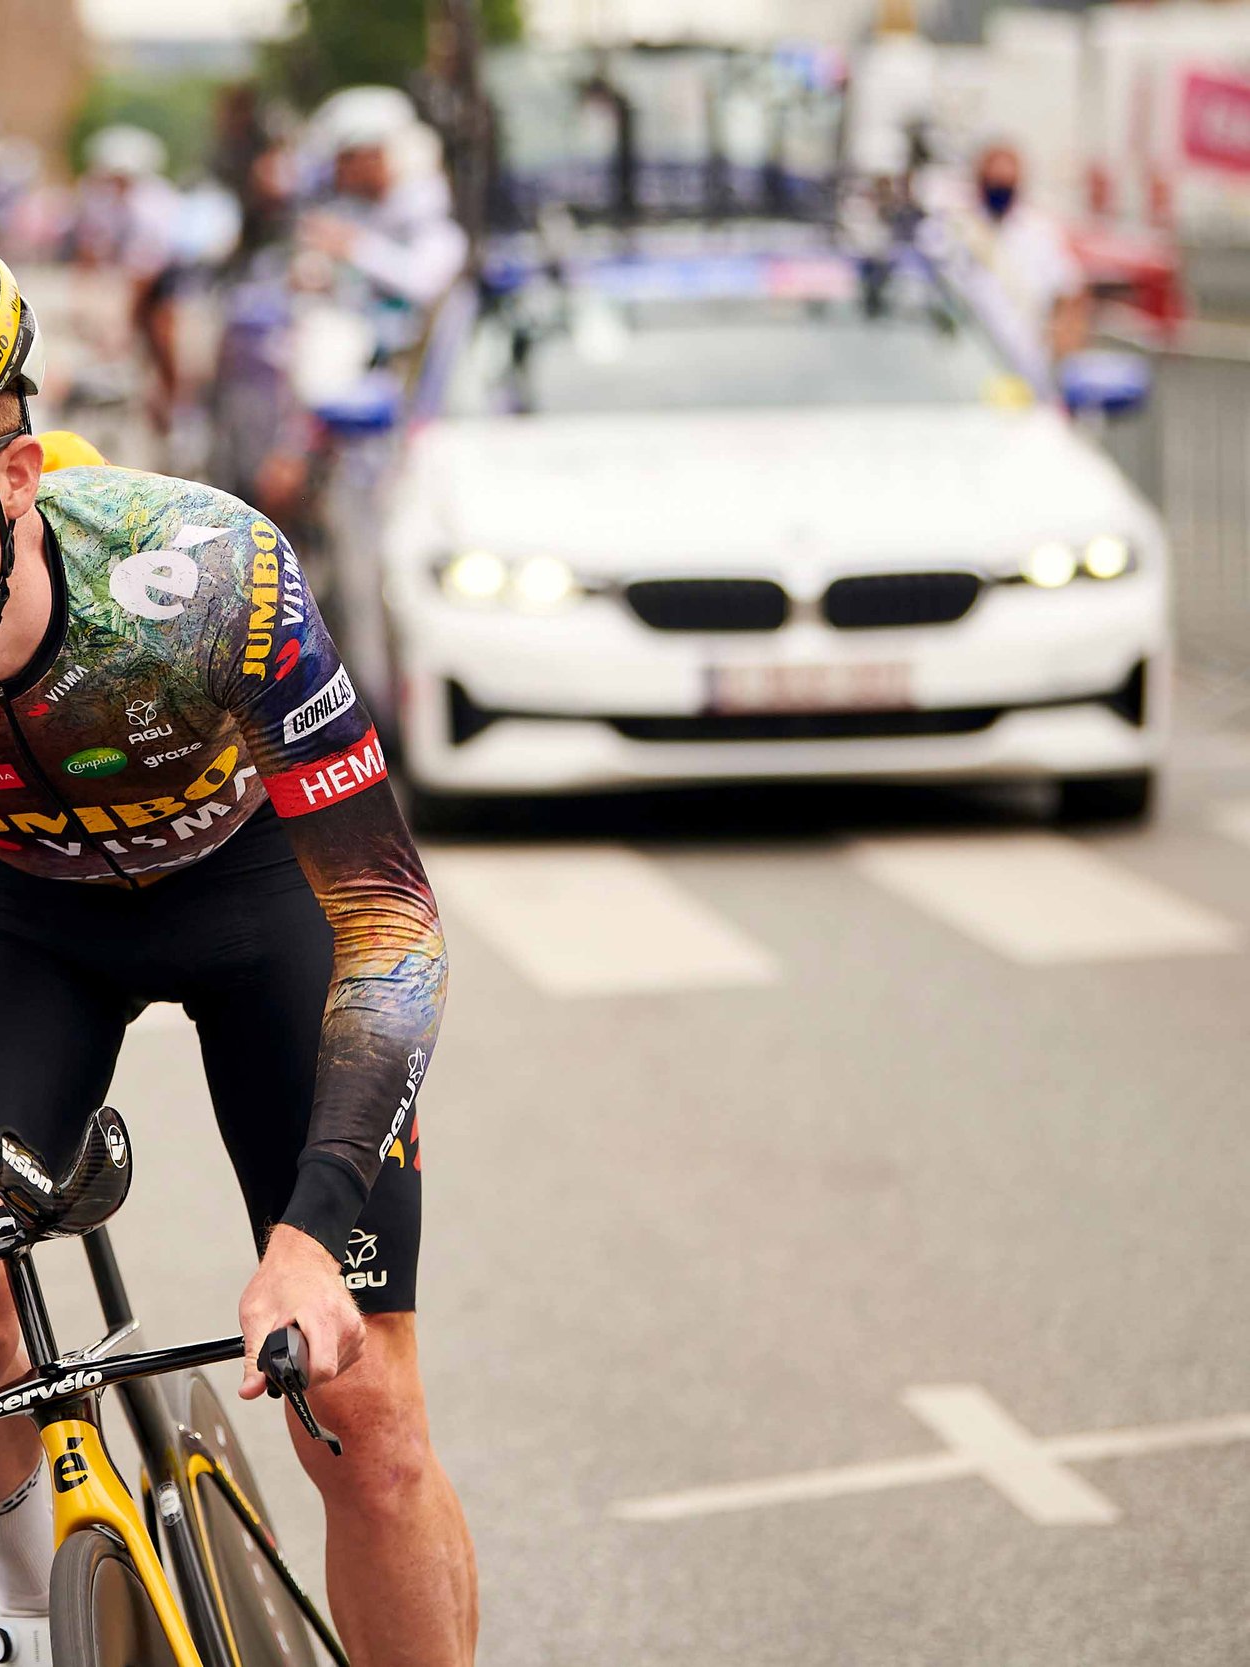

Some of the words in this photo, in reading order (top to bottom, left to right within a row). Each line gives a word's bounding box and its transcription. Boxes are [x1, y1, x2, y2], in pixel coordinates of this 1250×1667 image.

[242, 521, 280, 681] JUMBO
[44, 664, 89, 702] VISMA
[293, 674, 351, 734] GORILLAS
[128, 723, 173, 745] AGU
[143, 742, 203, 768] graze
[67, 753, 121, 774] Campina
[300, 737, 386, 805] HEMA
[36, 765, 257, 857] VISMA
[379, 1079, 416, 1163] AGU
[340, 1270, 388, 1290] GU
